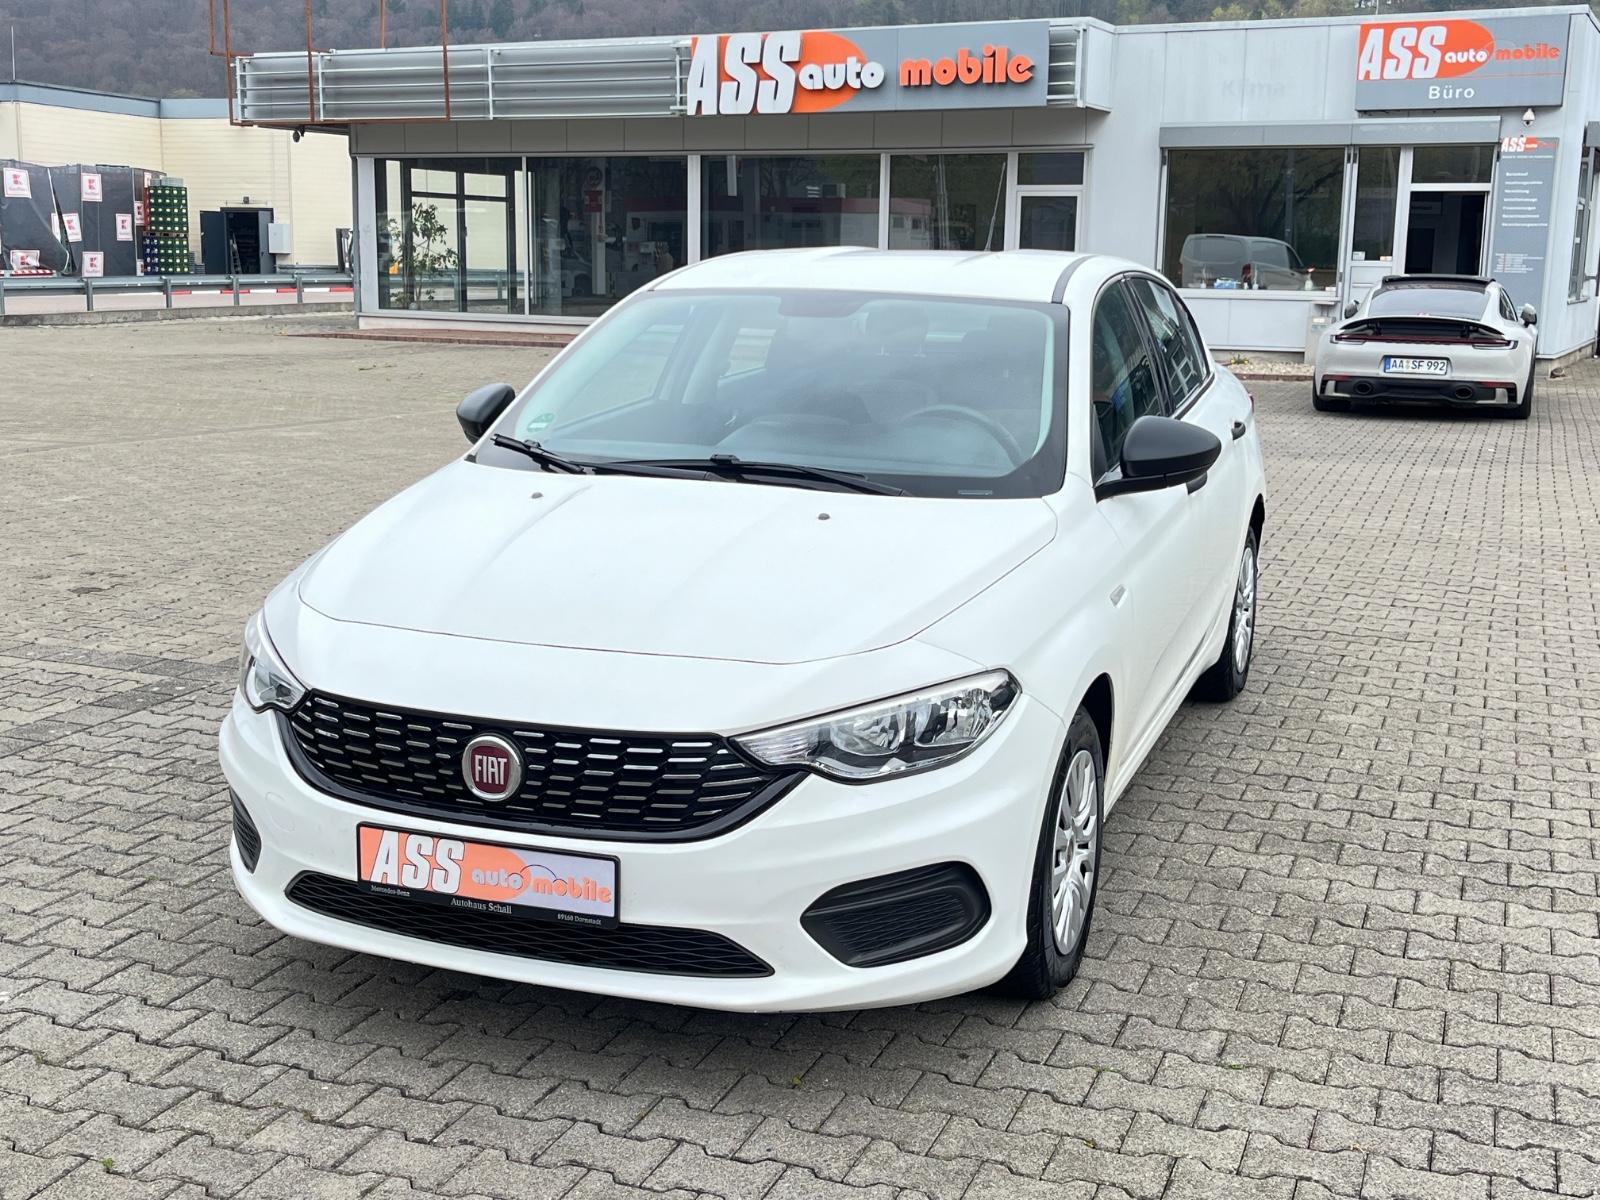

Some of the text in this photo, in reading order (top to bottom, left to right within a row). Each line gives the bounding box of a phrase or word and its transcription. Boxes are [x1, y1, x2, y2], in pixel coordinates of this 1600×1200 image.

[1358, 26, 1560, 80] ASS auto mobile
[687, 32, 1035, 116] ASS auto mobile
[1428, 85, 1476, 100] Büro
[1500, 137, 1526, 153] ASS
[1392, 360, 1446, 371] AA SF 992
[474, 754, 508, 786] FIAT
[370, 829, 612, 904] ASS auto mobile
[450, 897, 512, 915] Autohaus Schall
